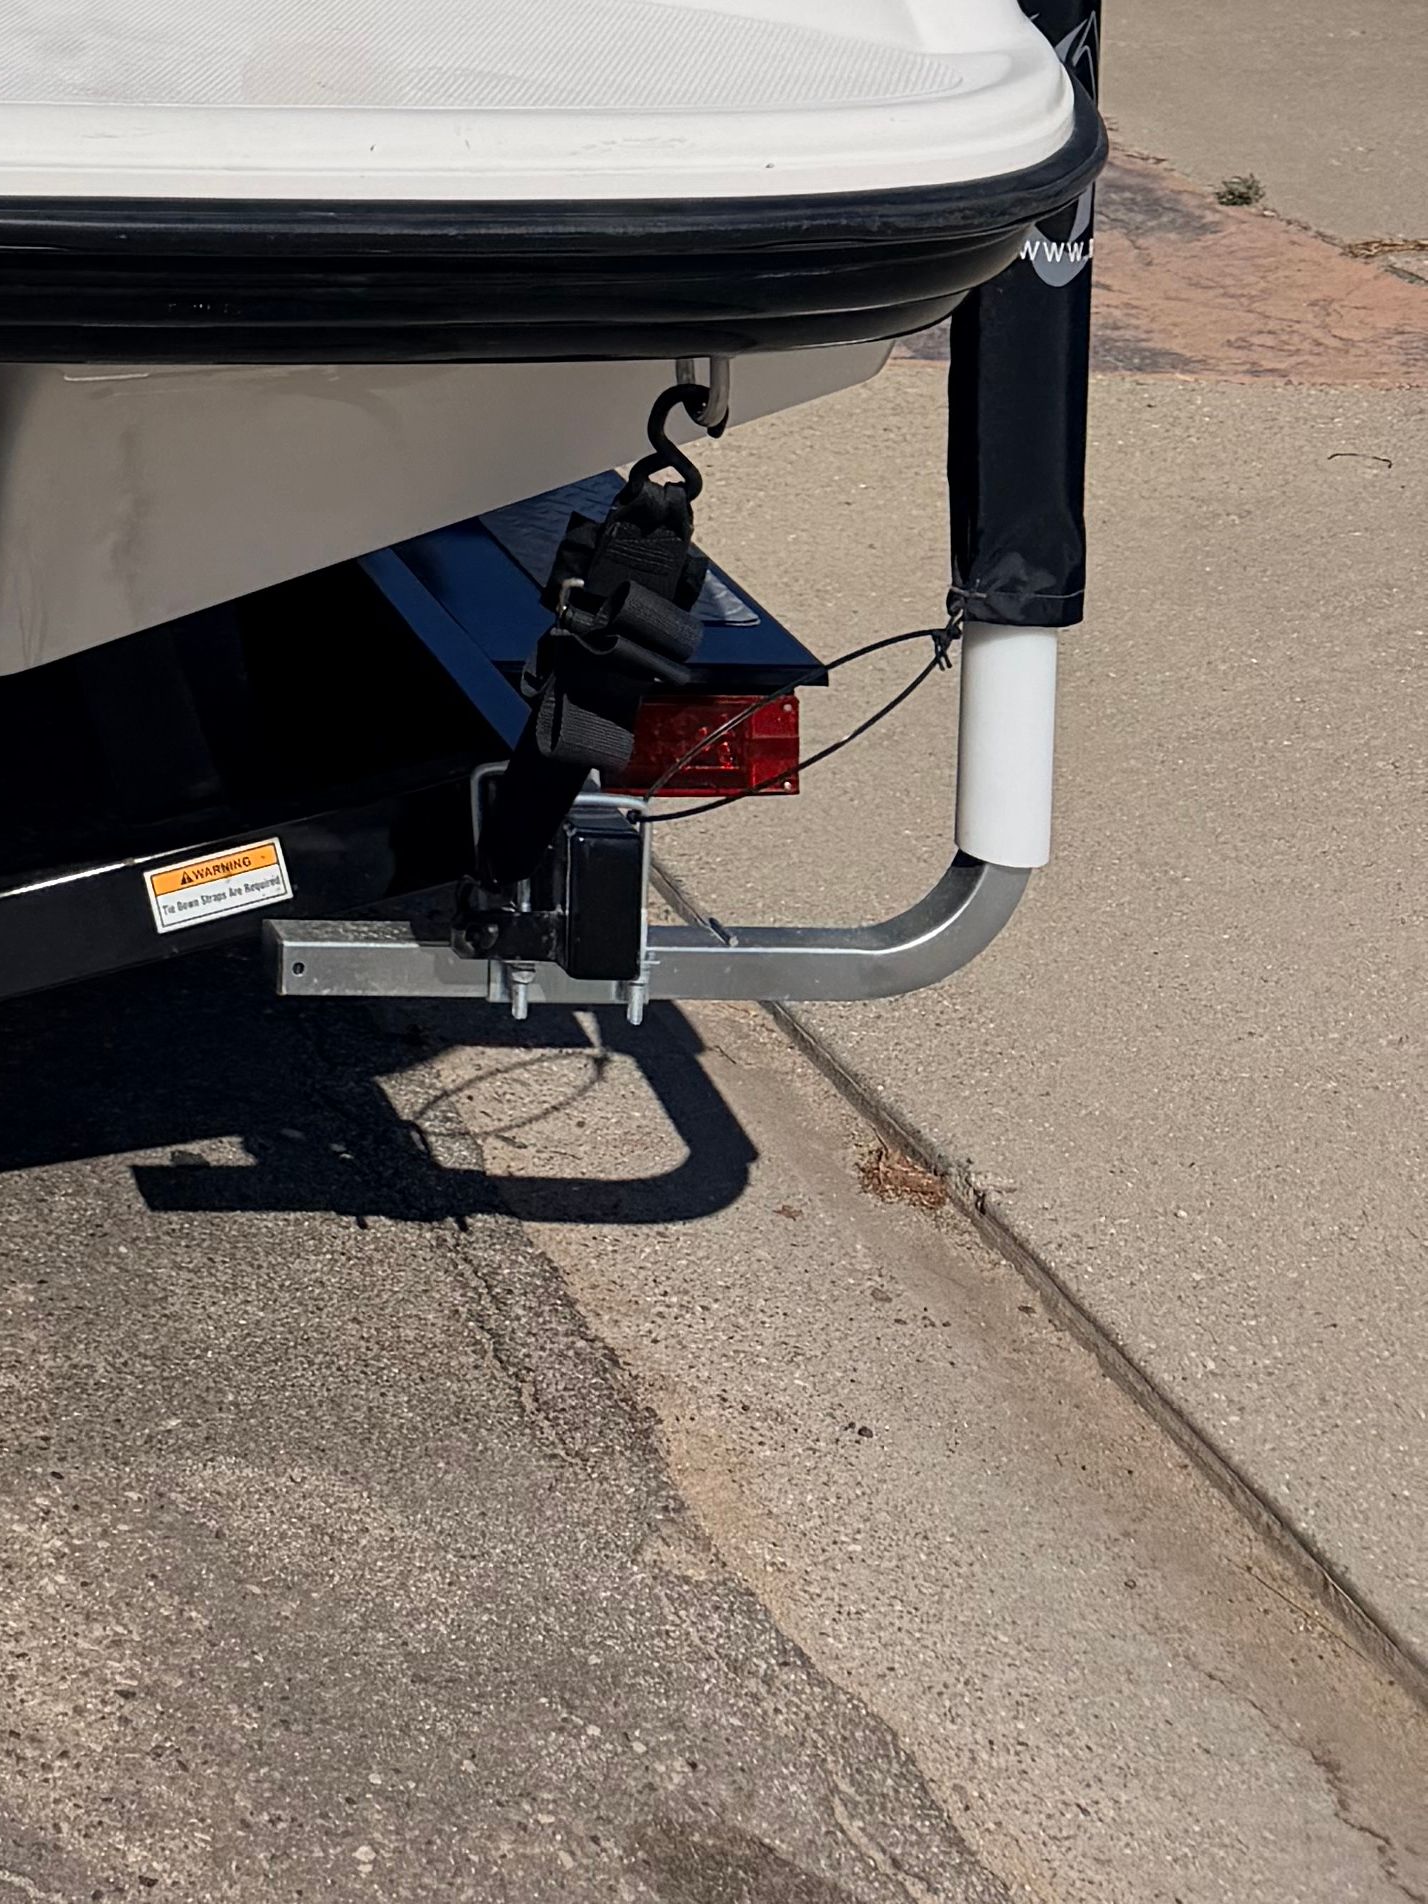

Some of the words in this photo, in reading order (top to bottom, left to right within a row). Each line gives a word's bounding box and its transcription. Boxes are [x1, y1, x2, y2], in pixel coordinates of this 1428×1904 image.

[191, 856, 252, 881] WARNING
[162, 903, 176, 916] Tie
[176, 898, 200, 913] Down
[200, 890, 227, 906] Straps
[228, 886, 243, 900] Are
[243, 874, 281, 895] Required
